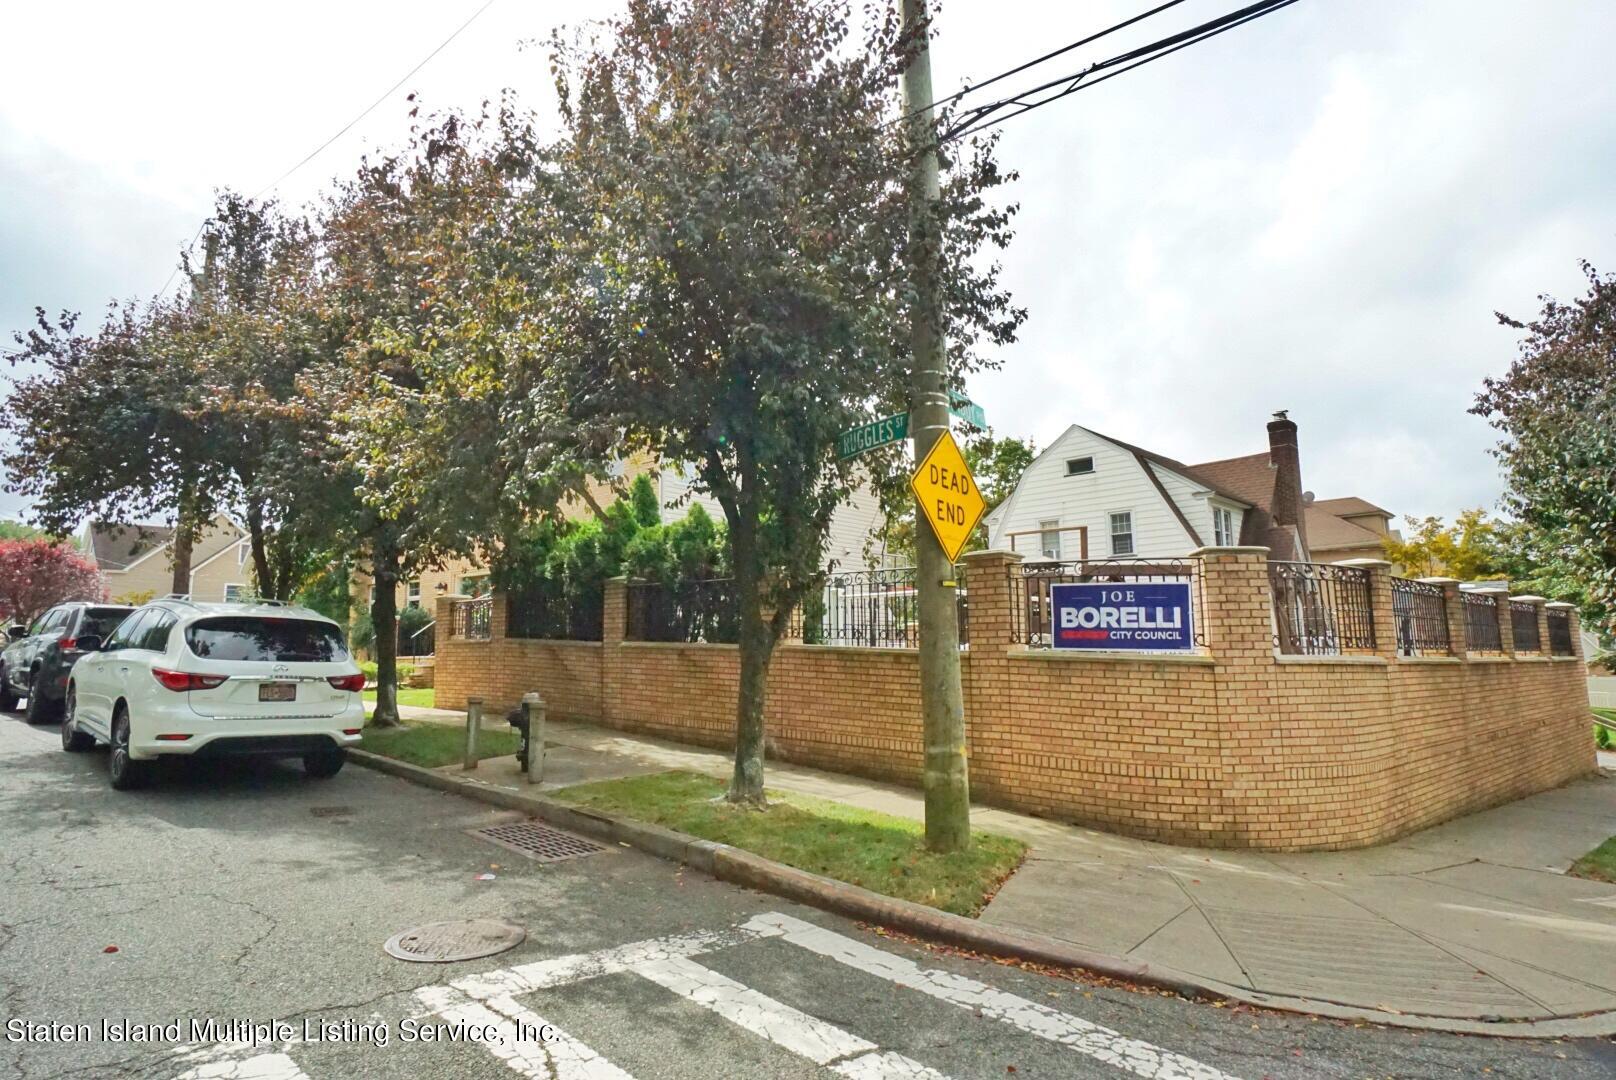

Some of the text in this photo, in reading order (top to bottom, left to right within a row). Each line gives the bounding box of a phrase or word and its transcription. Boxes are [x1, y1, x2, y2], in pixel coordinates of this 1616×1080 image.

[930, 464, 969, 495] DEAD
[936, 499, 965, 526] END
[1101, 590, 1136, 604] JOE
[1060, 606, 1182, 629] BORELLI
[1109, 630, 1182, 640] CITY COUNCIL
